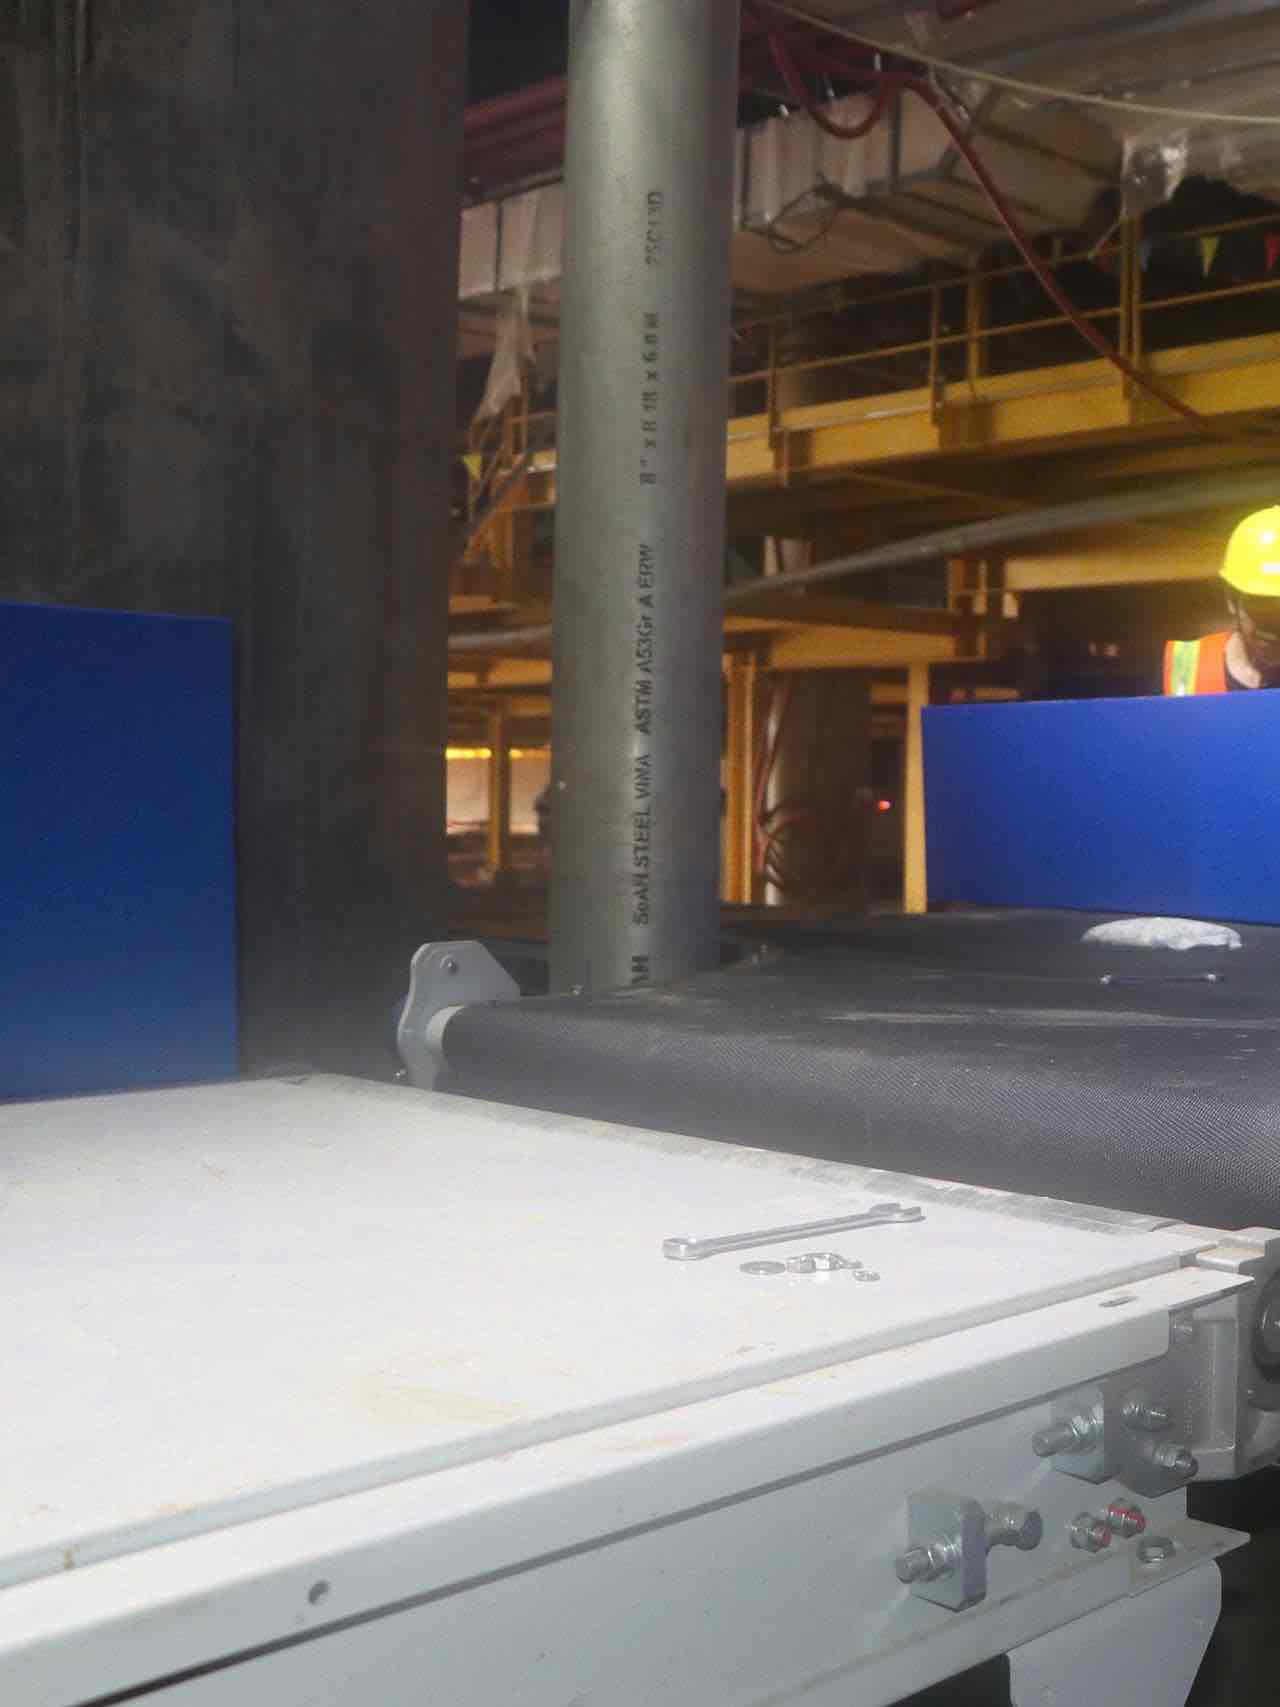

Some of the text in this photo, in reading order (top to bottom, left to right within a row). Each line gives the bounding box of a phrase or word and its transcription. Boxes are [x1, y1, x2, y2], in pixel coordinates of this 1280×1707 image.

[639, 543, 653, 589] ERW
[634, 679, 654, 735] ASTM
[634, 752, 652, 800] VINA
[632, 806, 651, 868] STEEL
